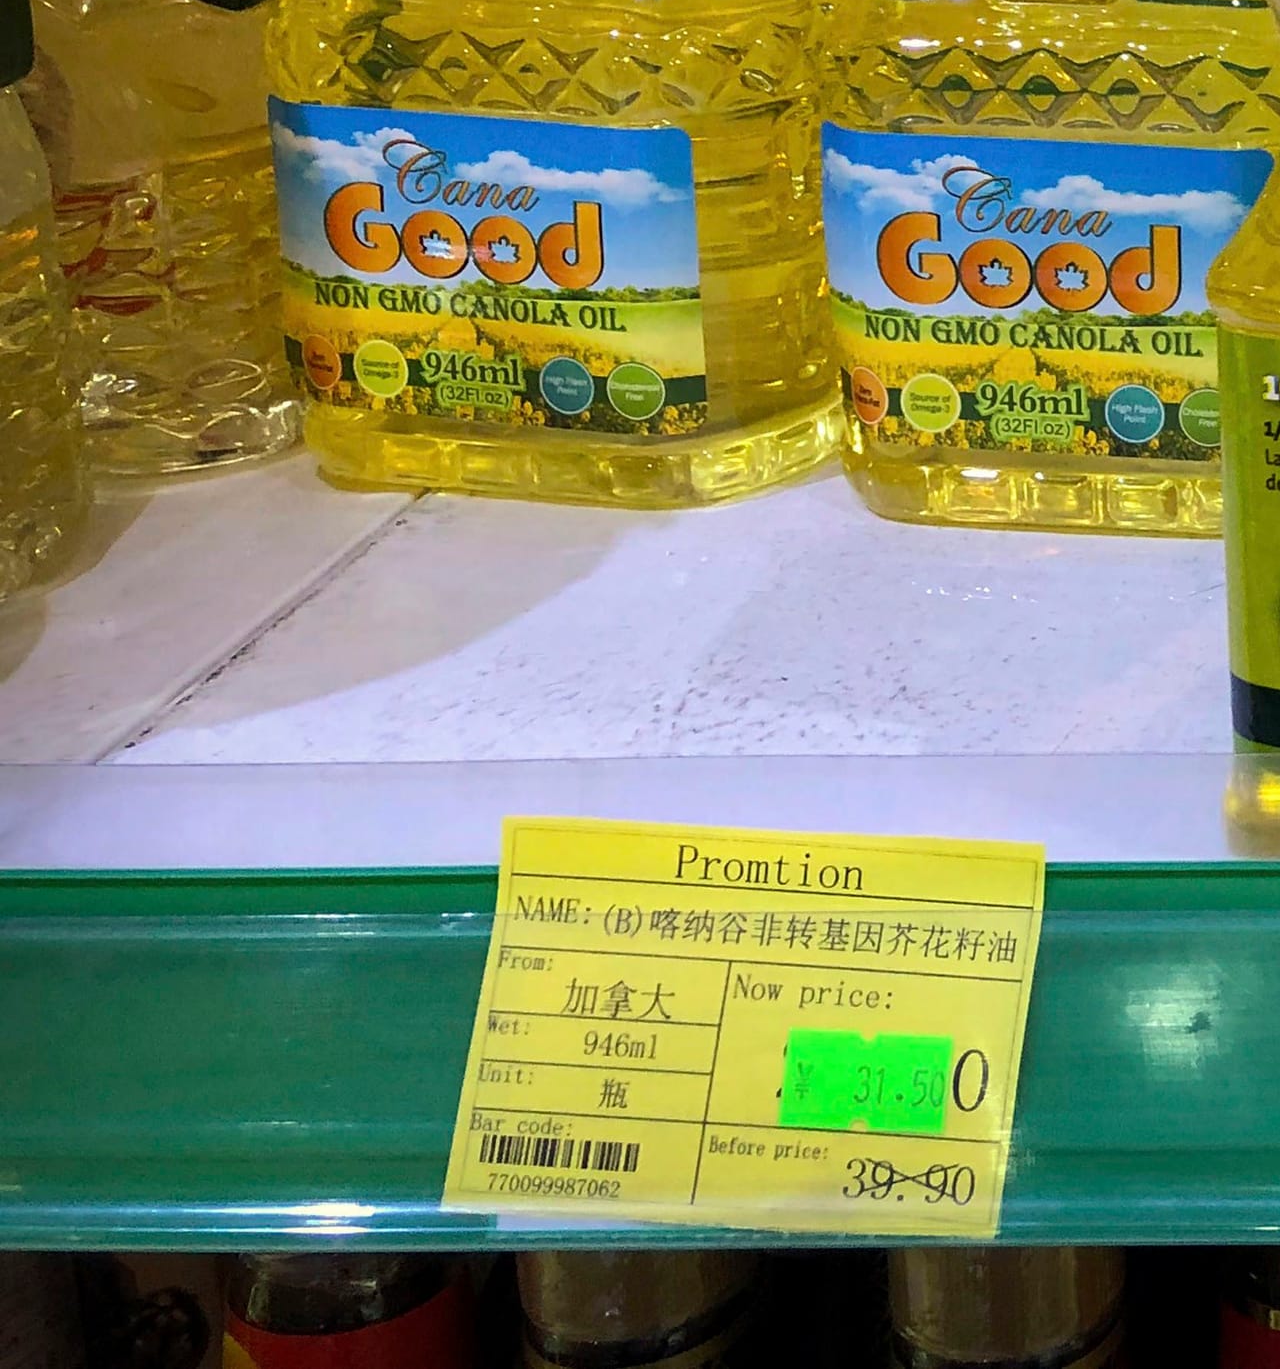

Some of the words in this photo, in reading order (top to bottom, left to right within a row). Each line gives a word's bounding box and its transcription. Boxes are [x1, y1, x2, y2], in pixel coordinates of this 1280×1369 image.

[383, 139, 540, 212] Cana
[942, 166, 1114, 238] Cana
[323, 182, 605, 290] Good
[877, 211, 1182, 315] Good
[315, 281, 369, 309] NON
[377, 289, 442, 316] GMO
[450, 294, 571, 329] CANOLA
[579, 307, 627, 332] OIL
[864, 314, 922, 341] NON
[930, 320, 1001, 347] GMO
[1009, 326, 1142, 355] CANOLA
[1151, 331, 1204, 358] OIL
[422, 354, 520, 386] 946ml
[980, 385, 1085, 417] 946ml
[676, 843, 864, 892] Promtion
[516, 895, 591, 927] NAME:
[498, 950, 554, 972] From:
[734, 974, 784, 1002] Now
[798, 983, 896, 1011] price:
[565, 977, 676, 1021] 加拿大
[487, 1016, 531, 1038] Wet:
[582, 1031, 659, 1061] 946ml
[477, 1064, 534, 1088] Unit:
[599, 1079, 630, 1110] 瓶
[853, 1067, 946, 1108] 31.50
[469, 1113, 508, 1134] Bar
[517, 1116, 573, 1137] code:
[708, 1136, 768, 1158] Before
[776, 1142, 829, 1161] price:
[487, 1173, 622, 1199] 770099987062
[843, 1157, 976, 1207] 39.90
